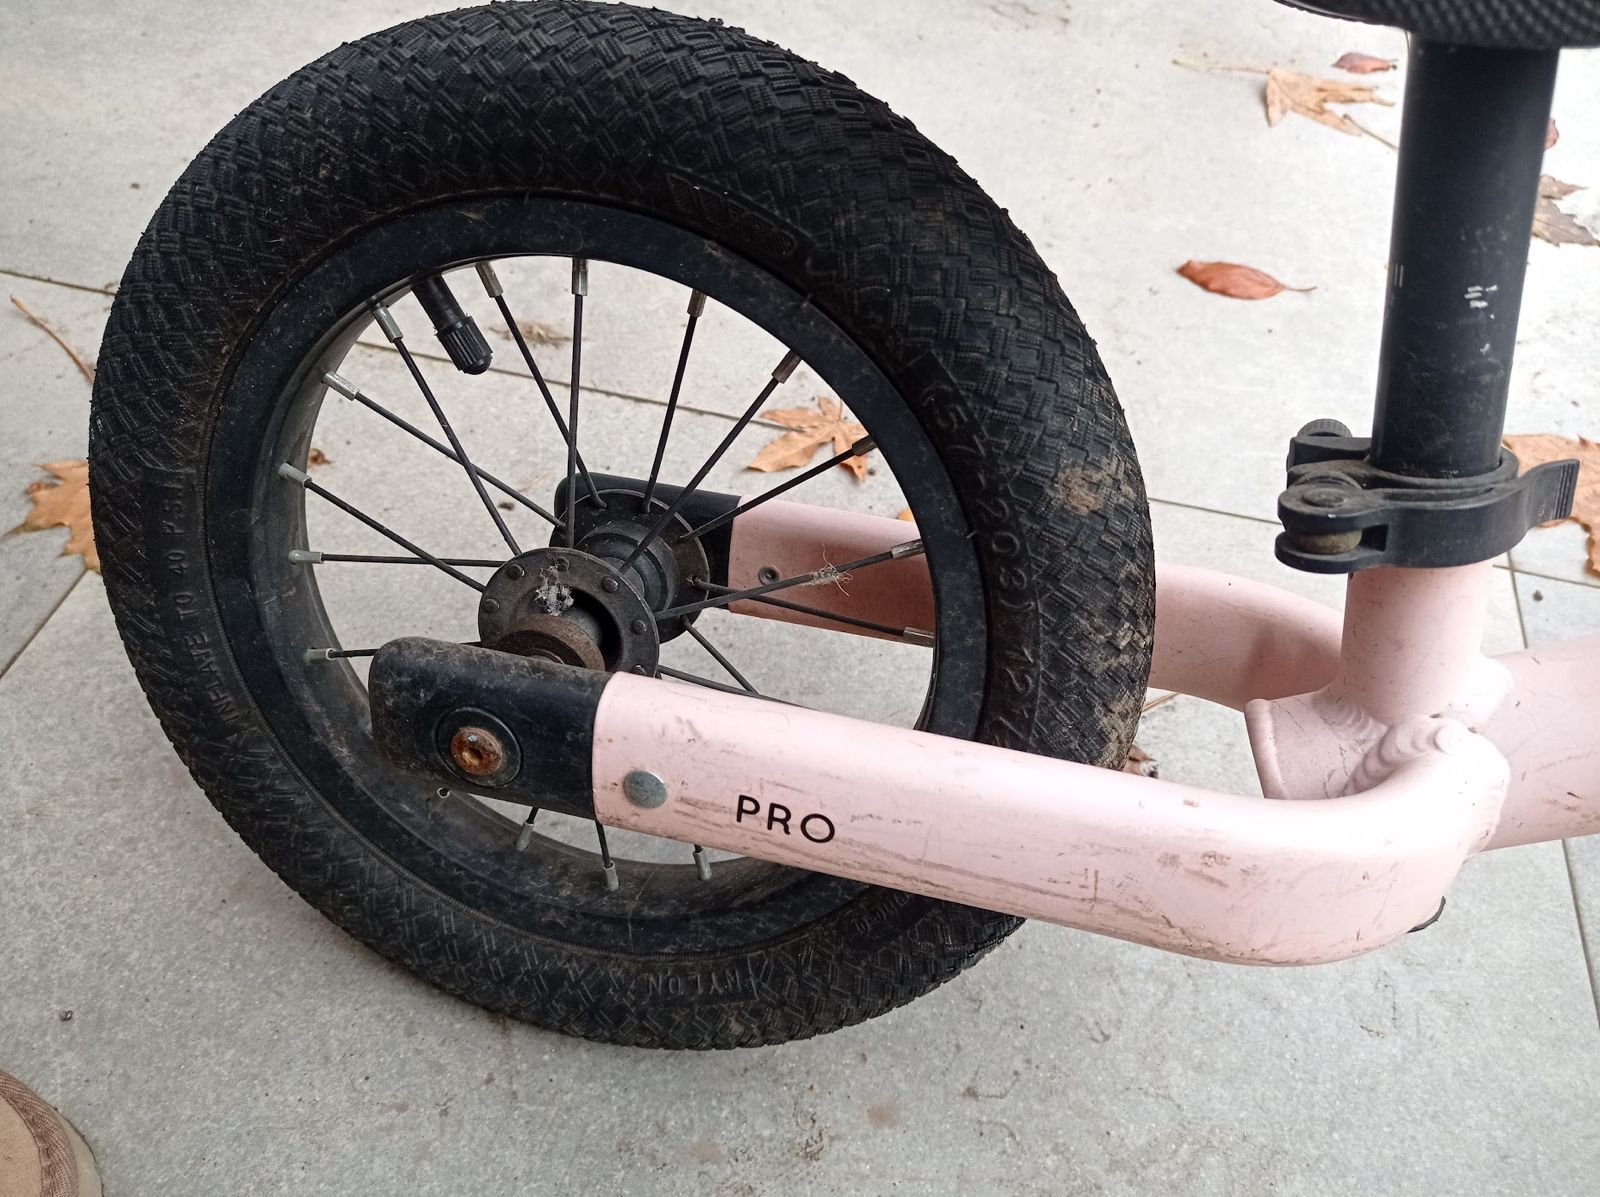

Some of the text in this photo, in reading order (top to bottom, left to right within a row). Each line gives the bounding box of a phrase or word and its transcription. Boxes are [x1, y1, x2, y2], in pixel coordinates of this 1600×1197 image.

[166, 550, 189, 575] 40
[174, 591, 200, 620] TO
[185, 631, 241, 725] INFLATE
[735, 793, 836, 844] PRO
[646, 967, 743, 999] NYLON
